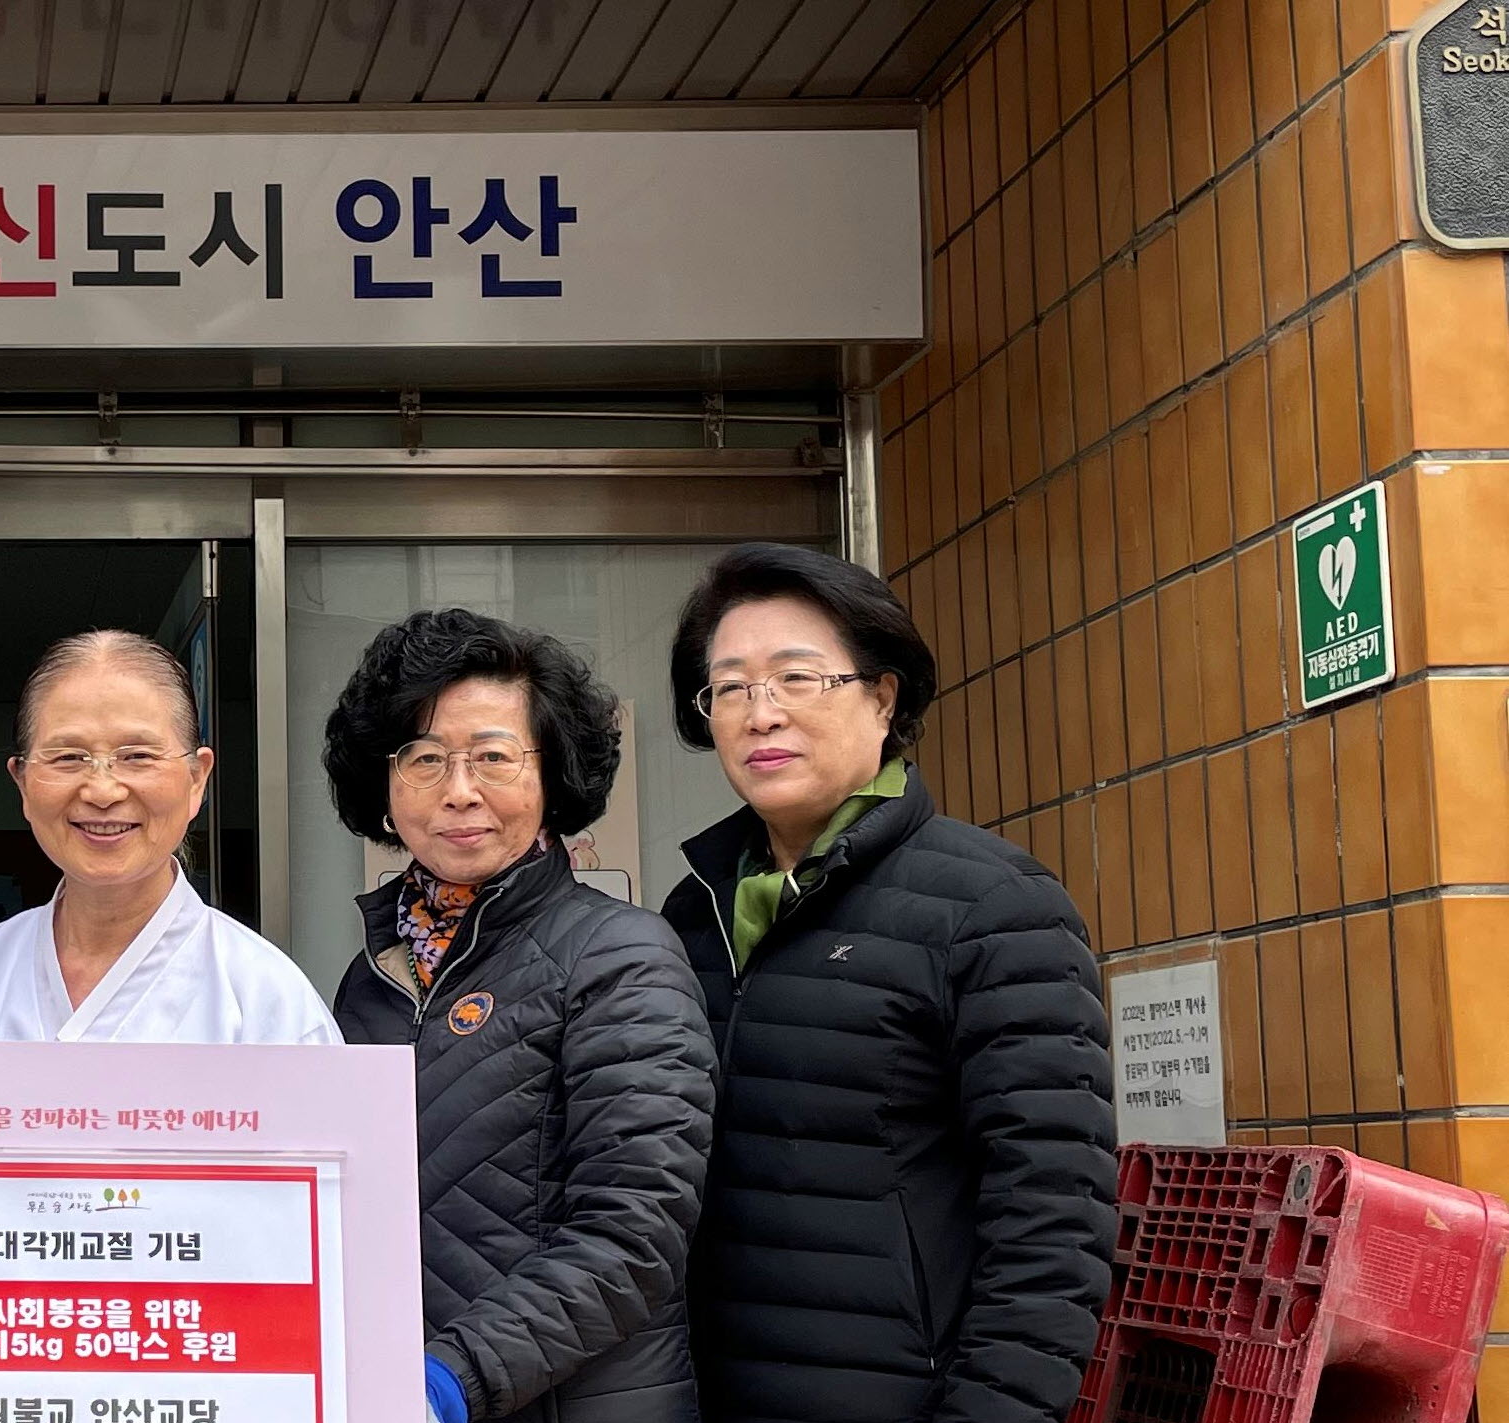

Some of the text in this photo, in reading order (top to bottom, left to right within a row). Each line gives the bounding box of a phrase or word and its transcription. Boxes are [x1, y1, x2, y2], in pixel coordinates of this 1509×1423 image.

[1470, 6, 1506, 45] 석
[1442, 46, 1509, 73] Seok
[336, 175, 577, 298] 안산
[1325, 612, 1358, 643] AED
[1308, 632, 1379, 678] 자동심장충격기
[21, 1108, 110, 1130] 전파하는
[117, 1108, 186, 1131] 따뜻한
[192, 1110, 259, 1131] 에너지
[148, 1233, 201, 1261] 기념
[144, 1299, 202, 1330] 위한
[75, 1331, 169, 1361] 50박스
[181, 1332, 237, 1362] 후원
